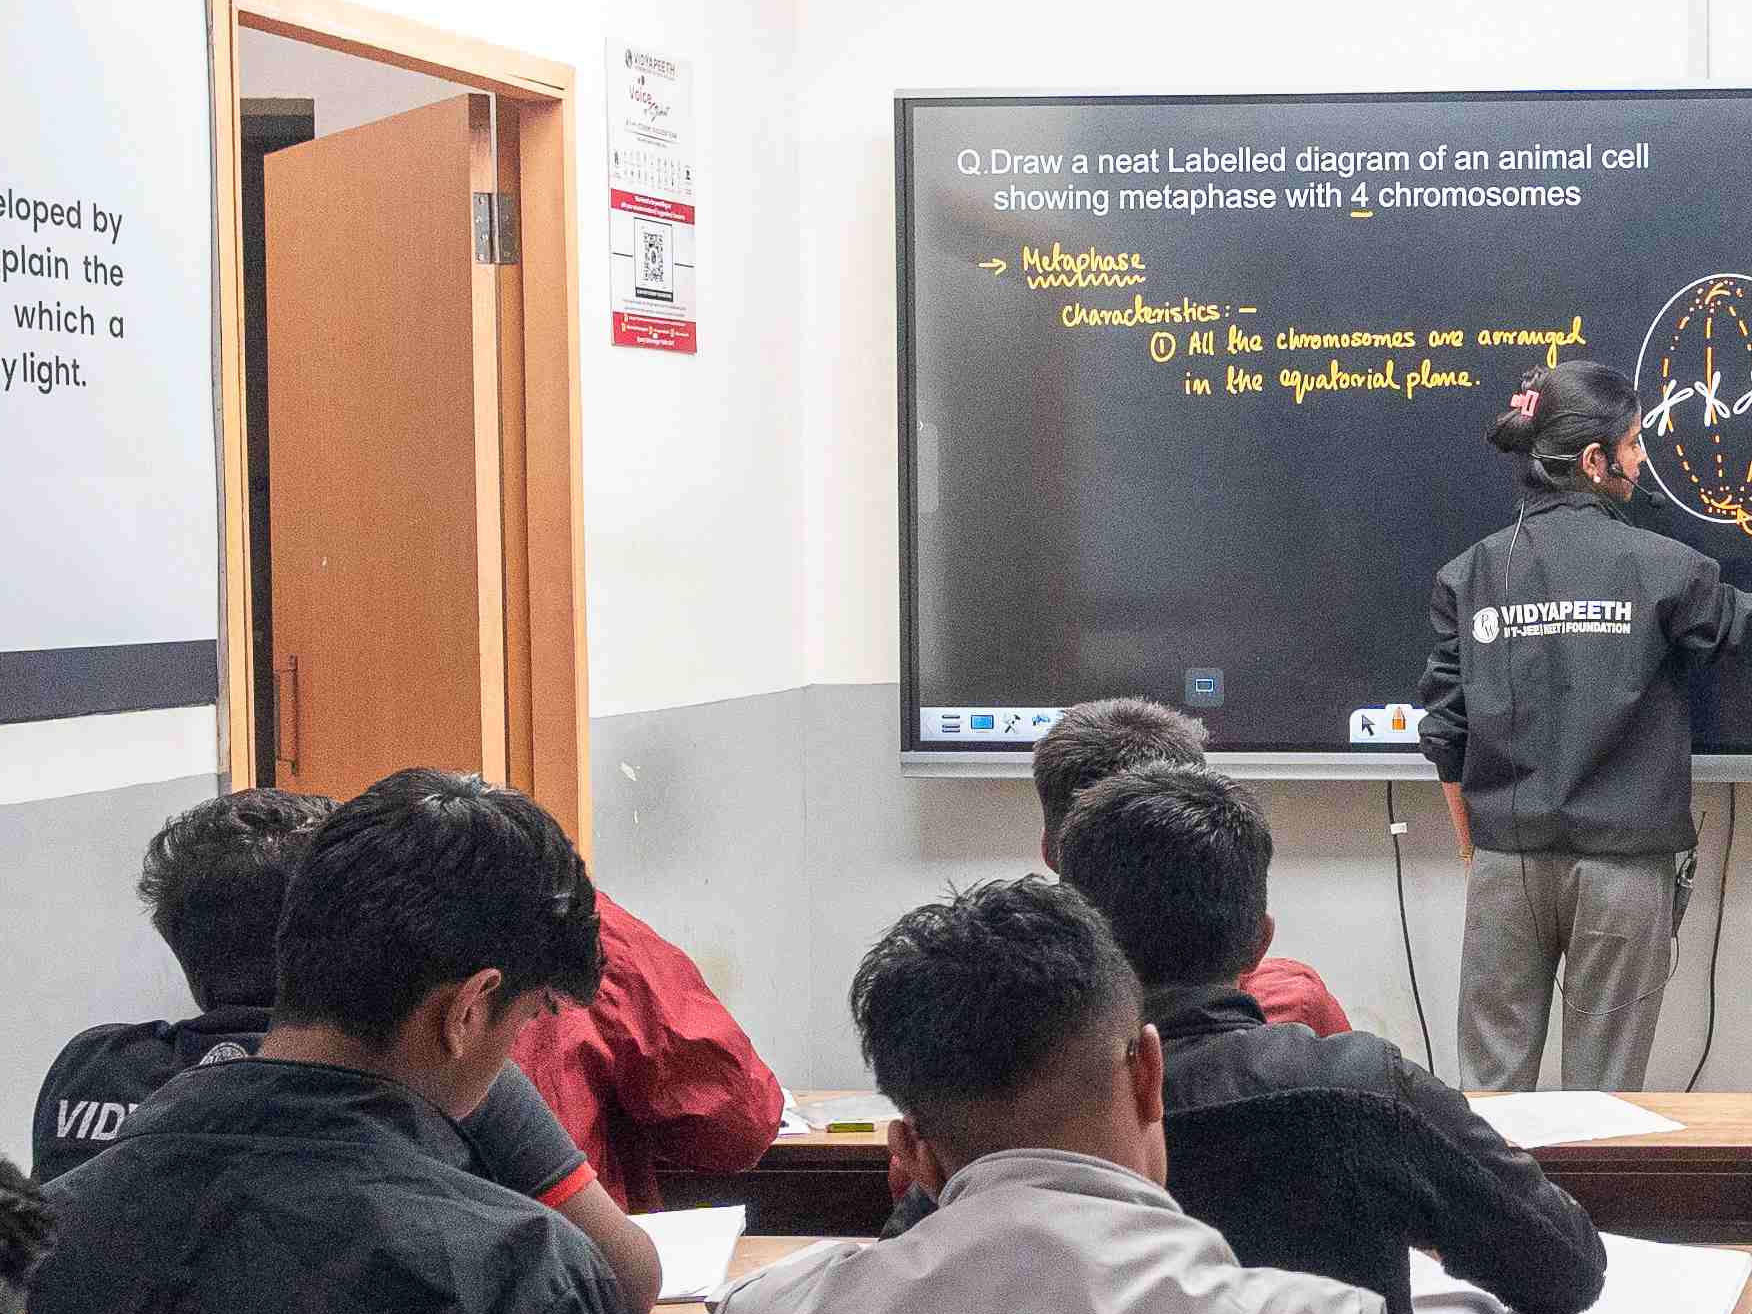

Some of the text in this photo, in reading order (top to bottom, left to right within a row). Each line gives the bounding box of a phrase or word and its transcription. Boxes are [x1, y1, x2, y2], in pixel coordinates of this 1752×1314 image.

[1071, 153, 1089, 174] a
[1098, 147, 1160, 174] neat
[1167, 146, 1286, 173] Labelled
[1295, 146, 1410, 178] diagram
[1418, 145, 1448, 172] of
[1454, 150, 1489, 172] an
[1498, 143, 1592, 171] animal
[1601, 143, 1649, 169] cell
[993, 181, 1582, 216] showing metaphase with 4 chromosomes
[93, 203, 122, 244] by
[83, 255, 123, 287] the
[1023, 242, 1145, 277] Metaphase
[14, 301, 94, 335] which
[109, 316, 123, 338] a
[1189, 330, 1215, 356] All
[1227, 325, 1263, 355] the
[1276, 327, 1416, 350] chromosomes
[1429, 330, 1464, 348] are
[1477, 316, 1586, 369] arranged
[22, 351, 87, 395] light.
[1185, 359, 1481, 404] in the equatorial plane.
[1501, 600, 1632, 624] VIDYAPEETH
[56, 1099, 140, 1141] VID
